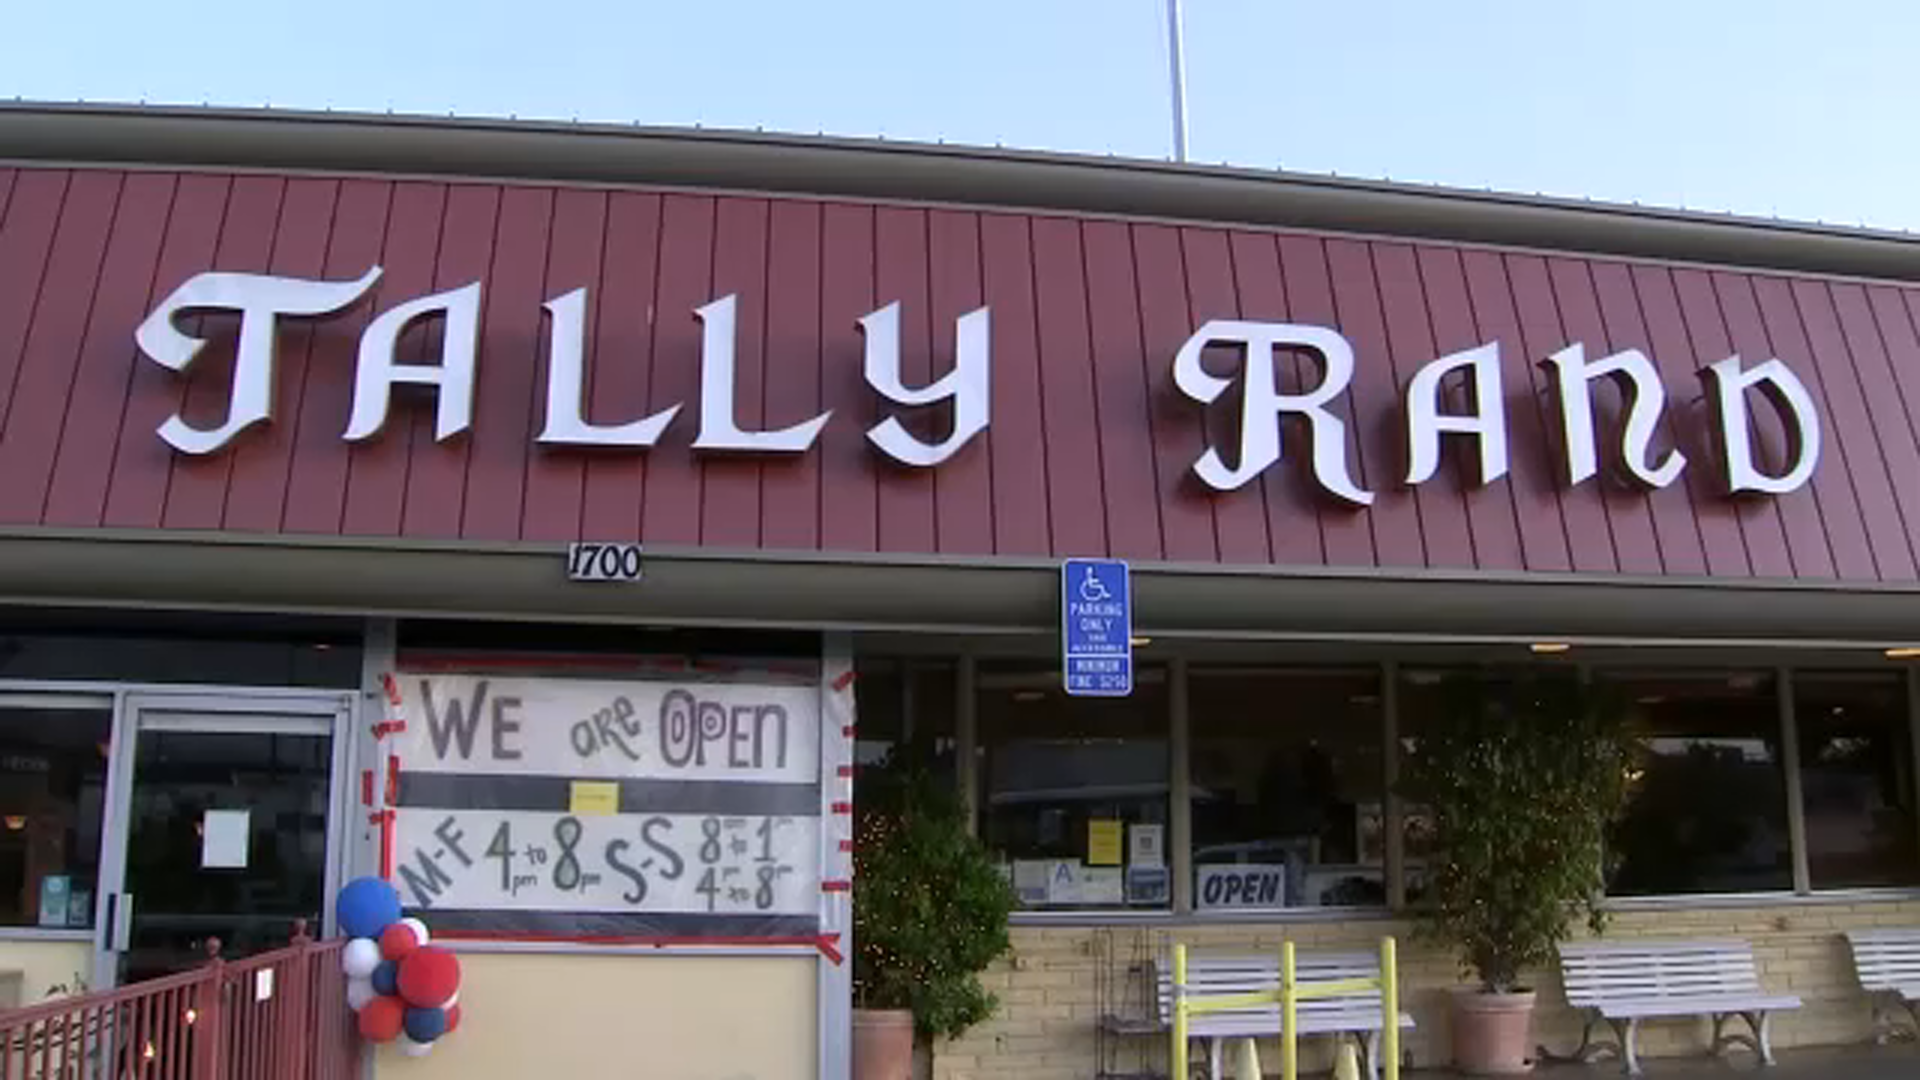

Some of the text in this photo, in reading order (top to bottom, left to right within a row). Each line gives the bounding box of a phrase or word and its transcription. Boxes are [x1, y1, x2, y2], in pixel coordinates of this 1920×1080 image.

[135, 266, 1822, 504] TALLY RAND
[569, 545, 641, 577] 1700
[1070, 602, 1123, 616] PARKING
[1080, 618, 1113, 631] ONLY
[420, 680, 522, 761] WE
[397, 815, 474, 911] M-F
[523, 844, 548, 866] to
[605, 816, 684, 905] S-S
[1203, 872, 1280, 904] OPEN
